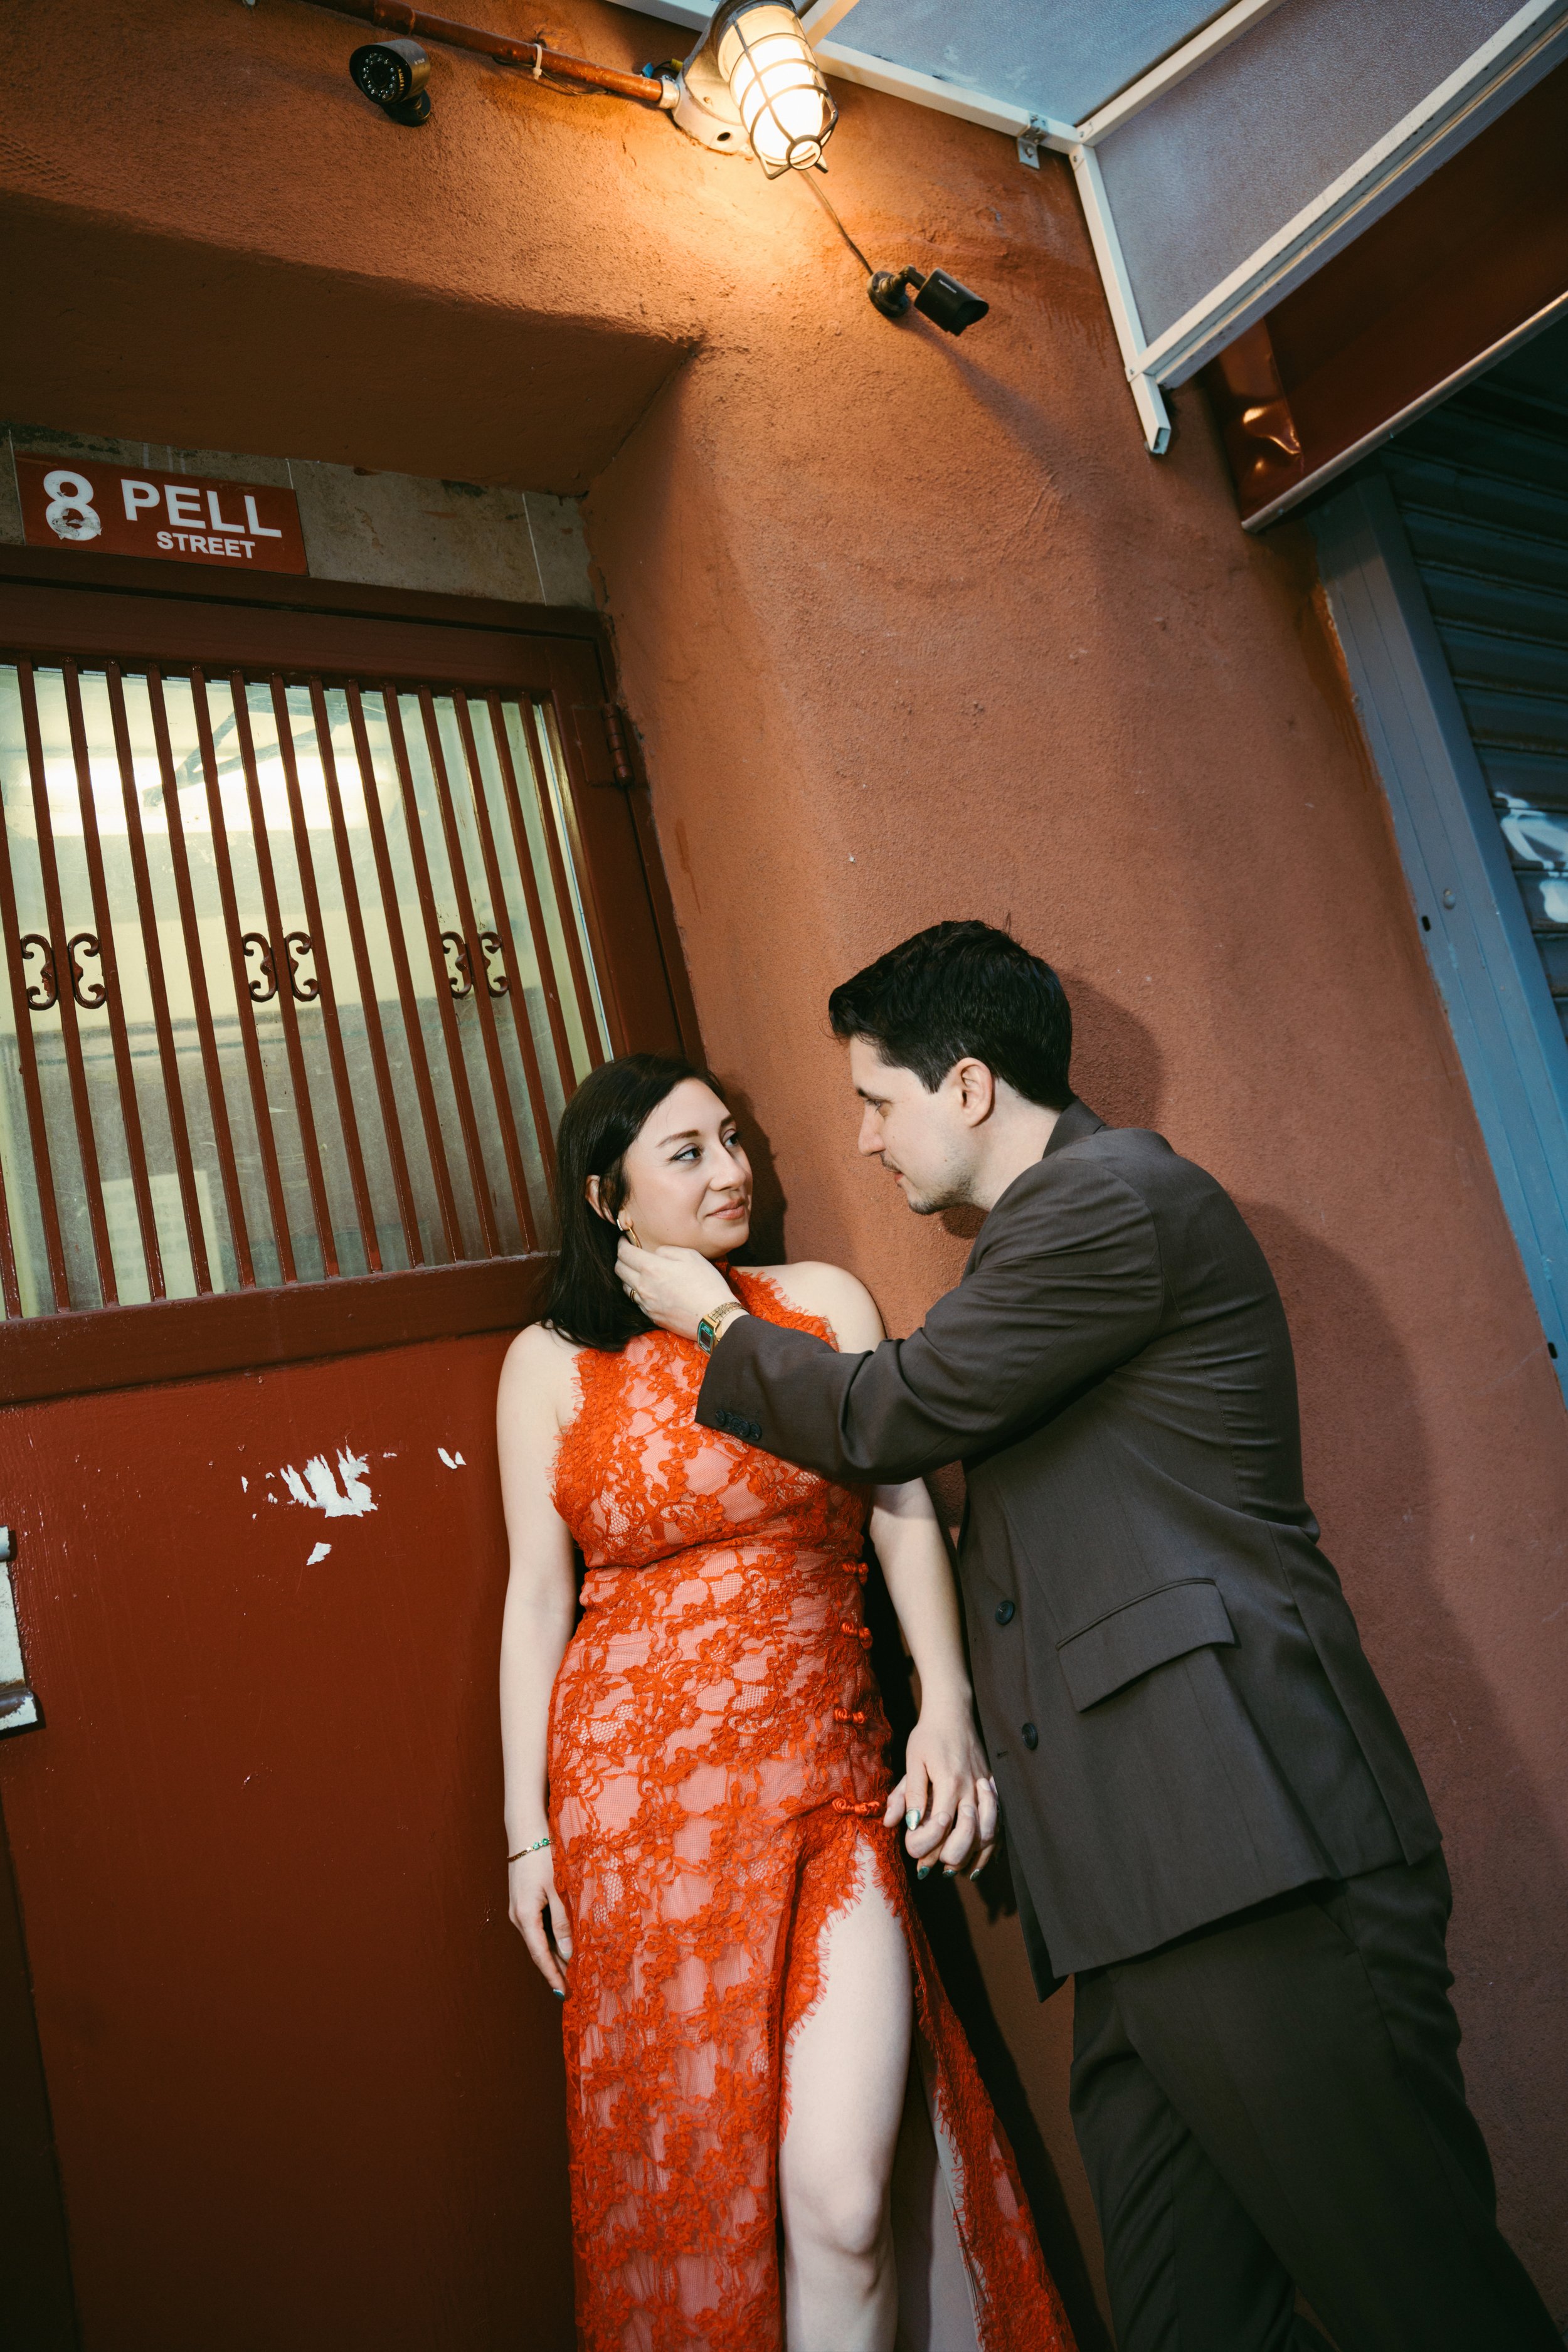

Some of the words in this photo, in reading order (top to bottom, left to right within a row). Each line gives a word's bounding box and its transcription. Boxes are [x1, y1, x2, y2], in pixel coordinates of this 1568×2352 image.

[43, 470, 102, 541] 8
[120, 479, 282, 538] PELL
[157, 531, 255, 559] STREET
